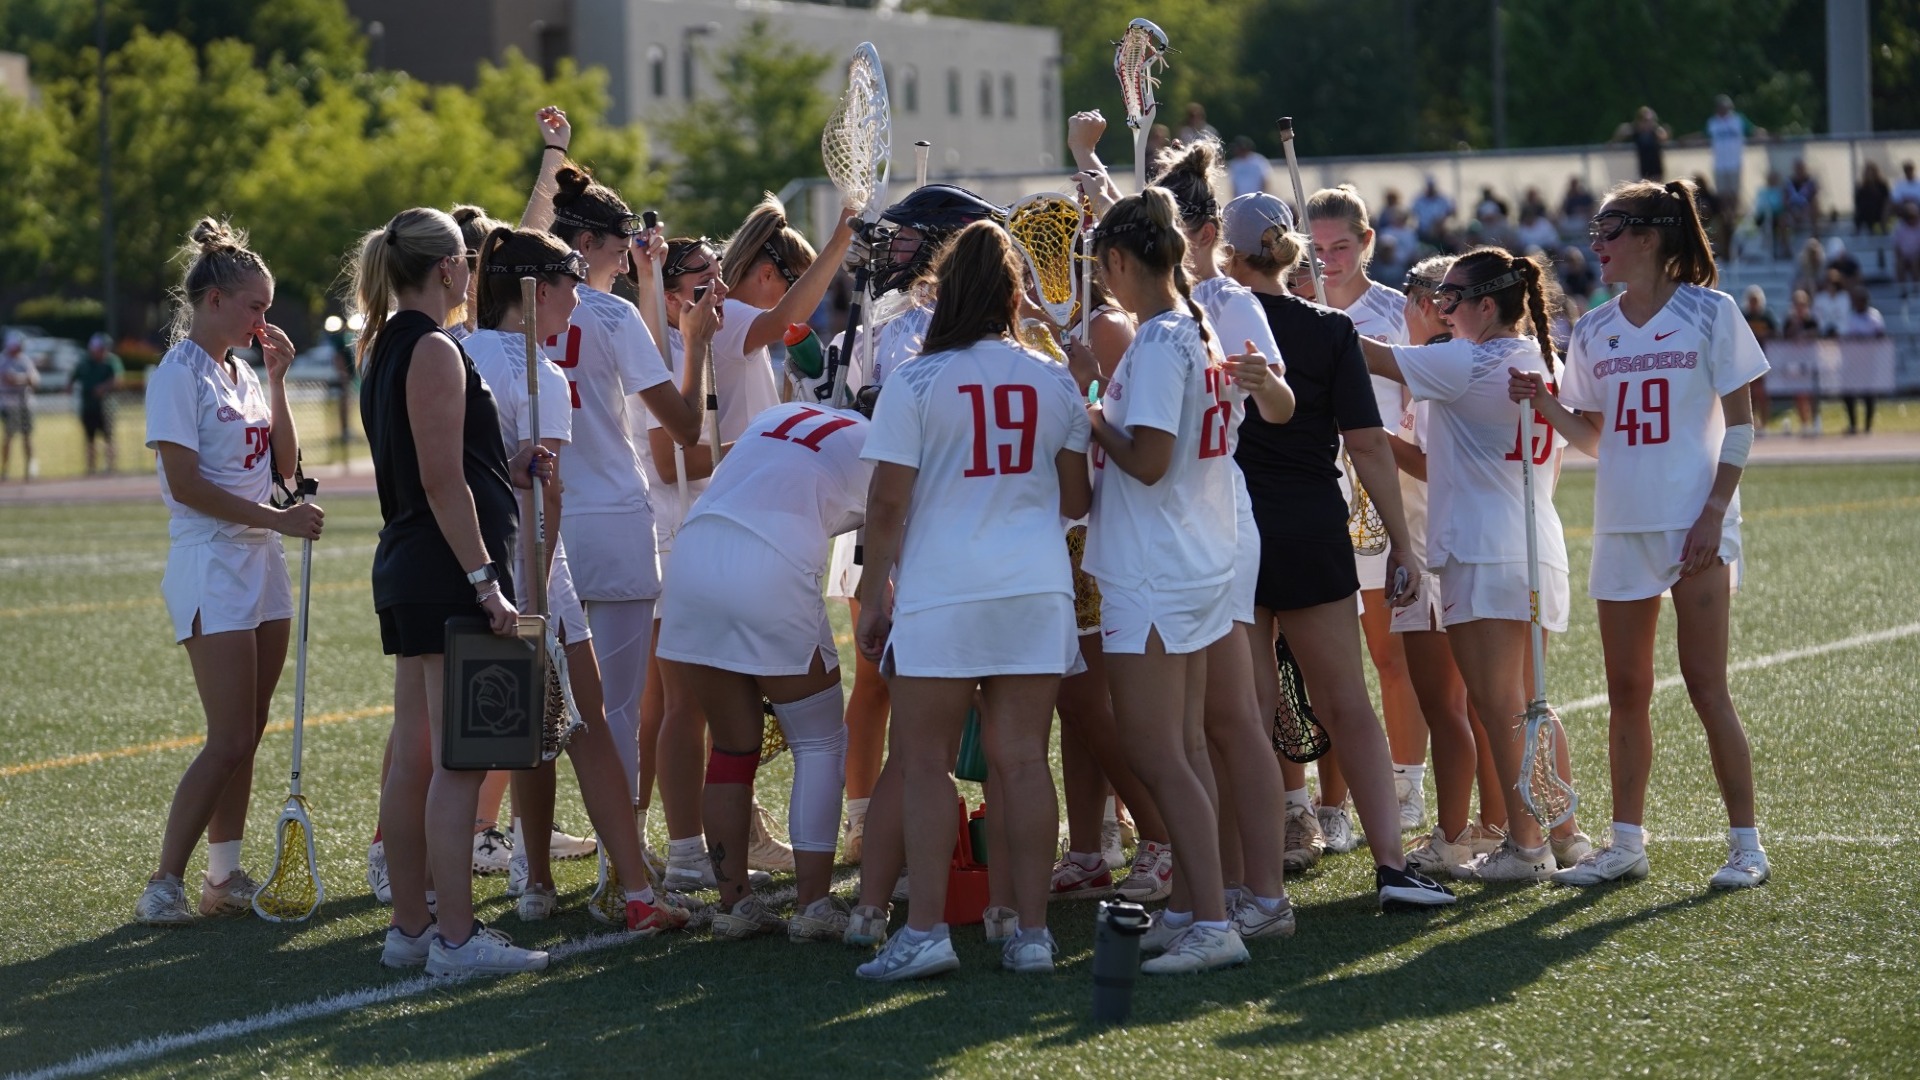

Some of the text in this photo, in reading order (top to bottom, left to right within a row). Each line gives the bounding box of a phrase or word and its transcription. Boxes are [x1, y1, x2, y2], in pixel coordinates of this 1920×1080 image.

[1113, 223, 1138, 233] STX
[1651, 216, 1674, 224] STX
[515, 264, 539, 273] STX
[544, 263, 566, 272] STX
[764, 241, 799, 282] STX ST
[1473, 281, 1498, 295] STX
[1593, 351, 1698, 380] CRUSADERS
[1615, 378, 1670, 447] 49
[957, 383, 1039, 478] 19
